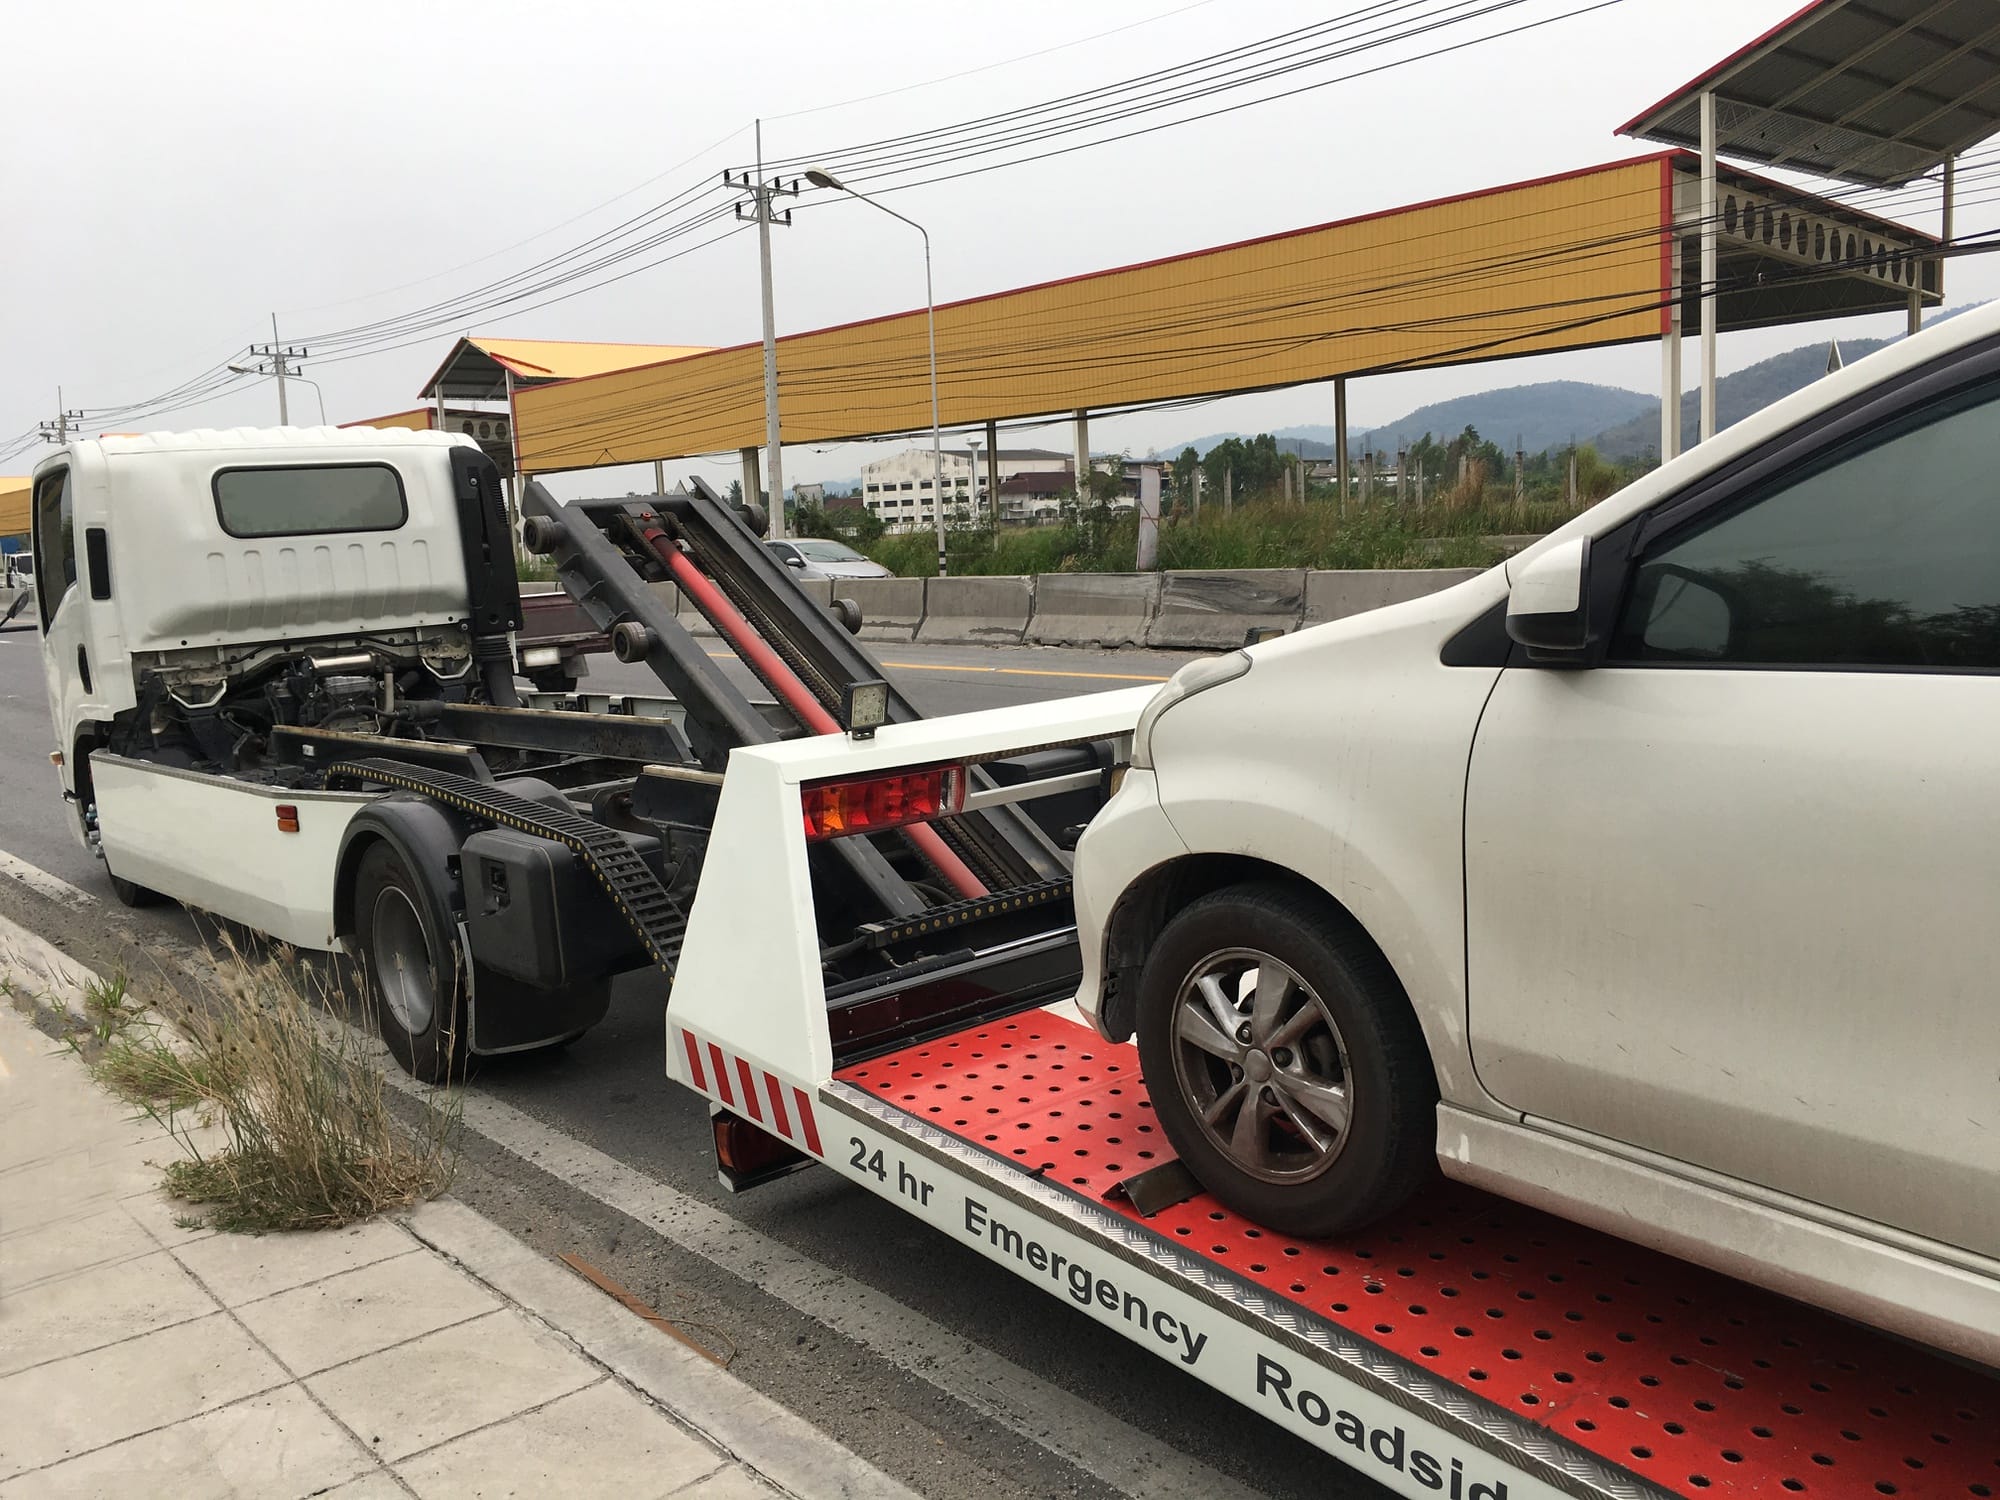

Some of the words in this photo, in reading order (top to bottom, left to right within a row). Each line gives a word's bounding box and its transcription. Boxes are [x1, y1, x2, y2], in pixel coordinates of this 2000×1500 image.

[850, 1136, 887, 1182] 24
[899, 1161, 934, 1206] hr
[964, 1196, 1208, 1365] Emergency
